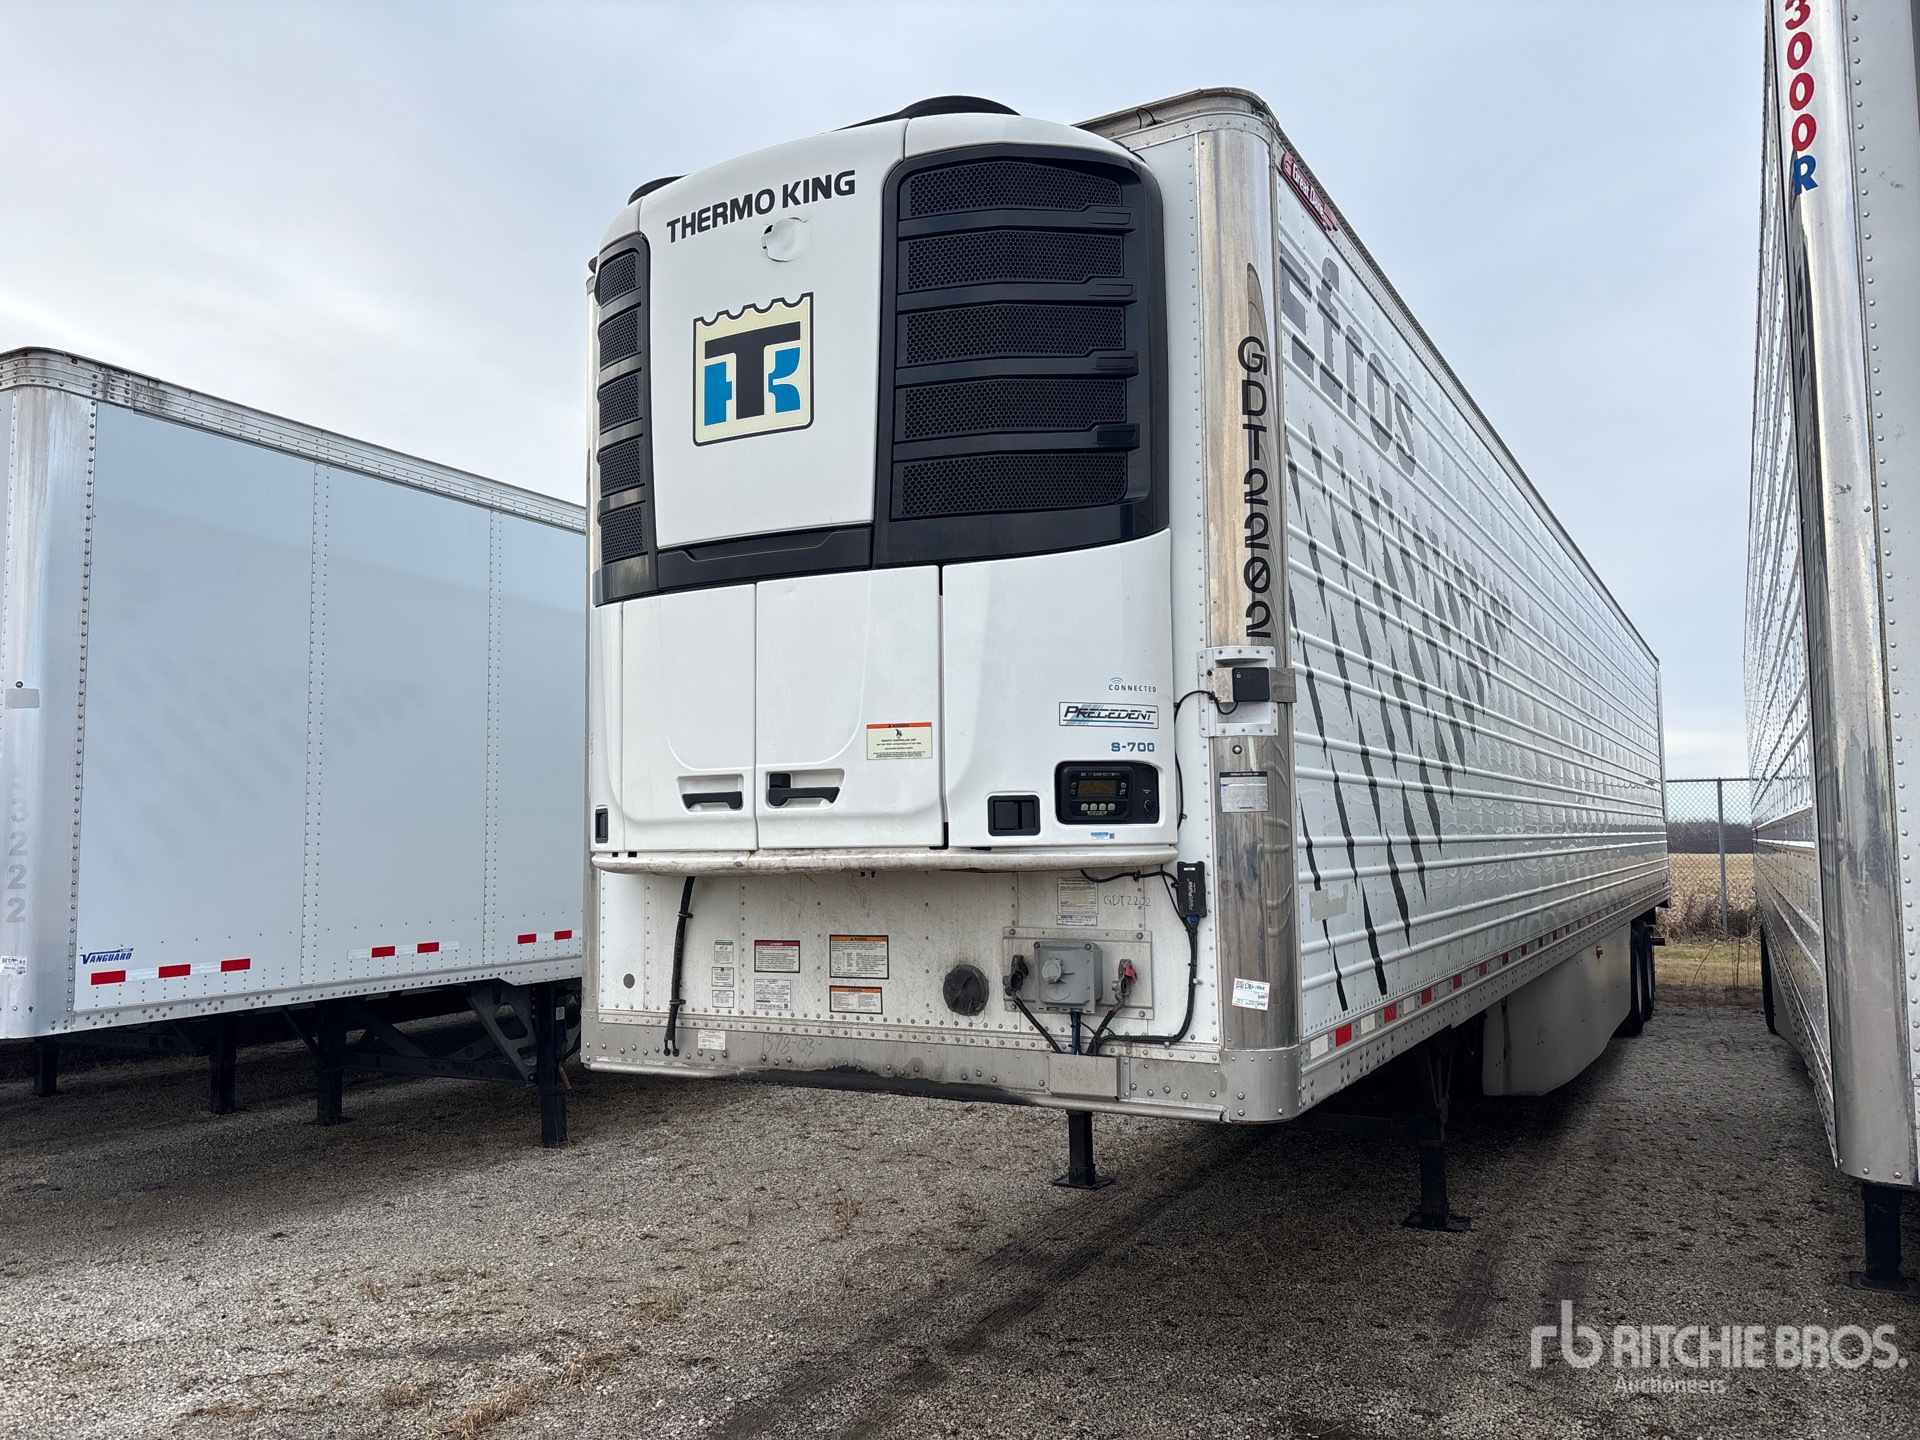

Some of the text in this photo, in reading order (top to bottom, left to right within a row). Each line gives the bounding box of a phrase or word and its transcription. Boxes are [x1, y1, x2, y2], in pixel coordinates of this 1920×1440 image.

[666, 169, 856, 244] THERMO KING
[1280, 243, 1417, 478] Efros
[1237, 335, 1272, 639] GDT2202
[1108, 684, 1157, 693] CONNECTED
[1063, 705, 1157, 721] PRECEDENT
[1103, 894, 1152, 907] GDT2202
[79, 949, 134, 965] VANGUARD
